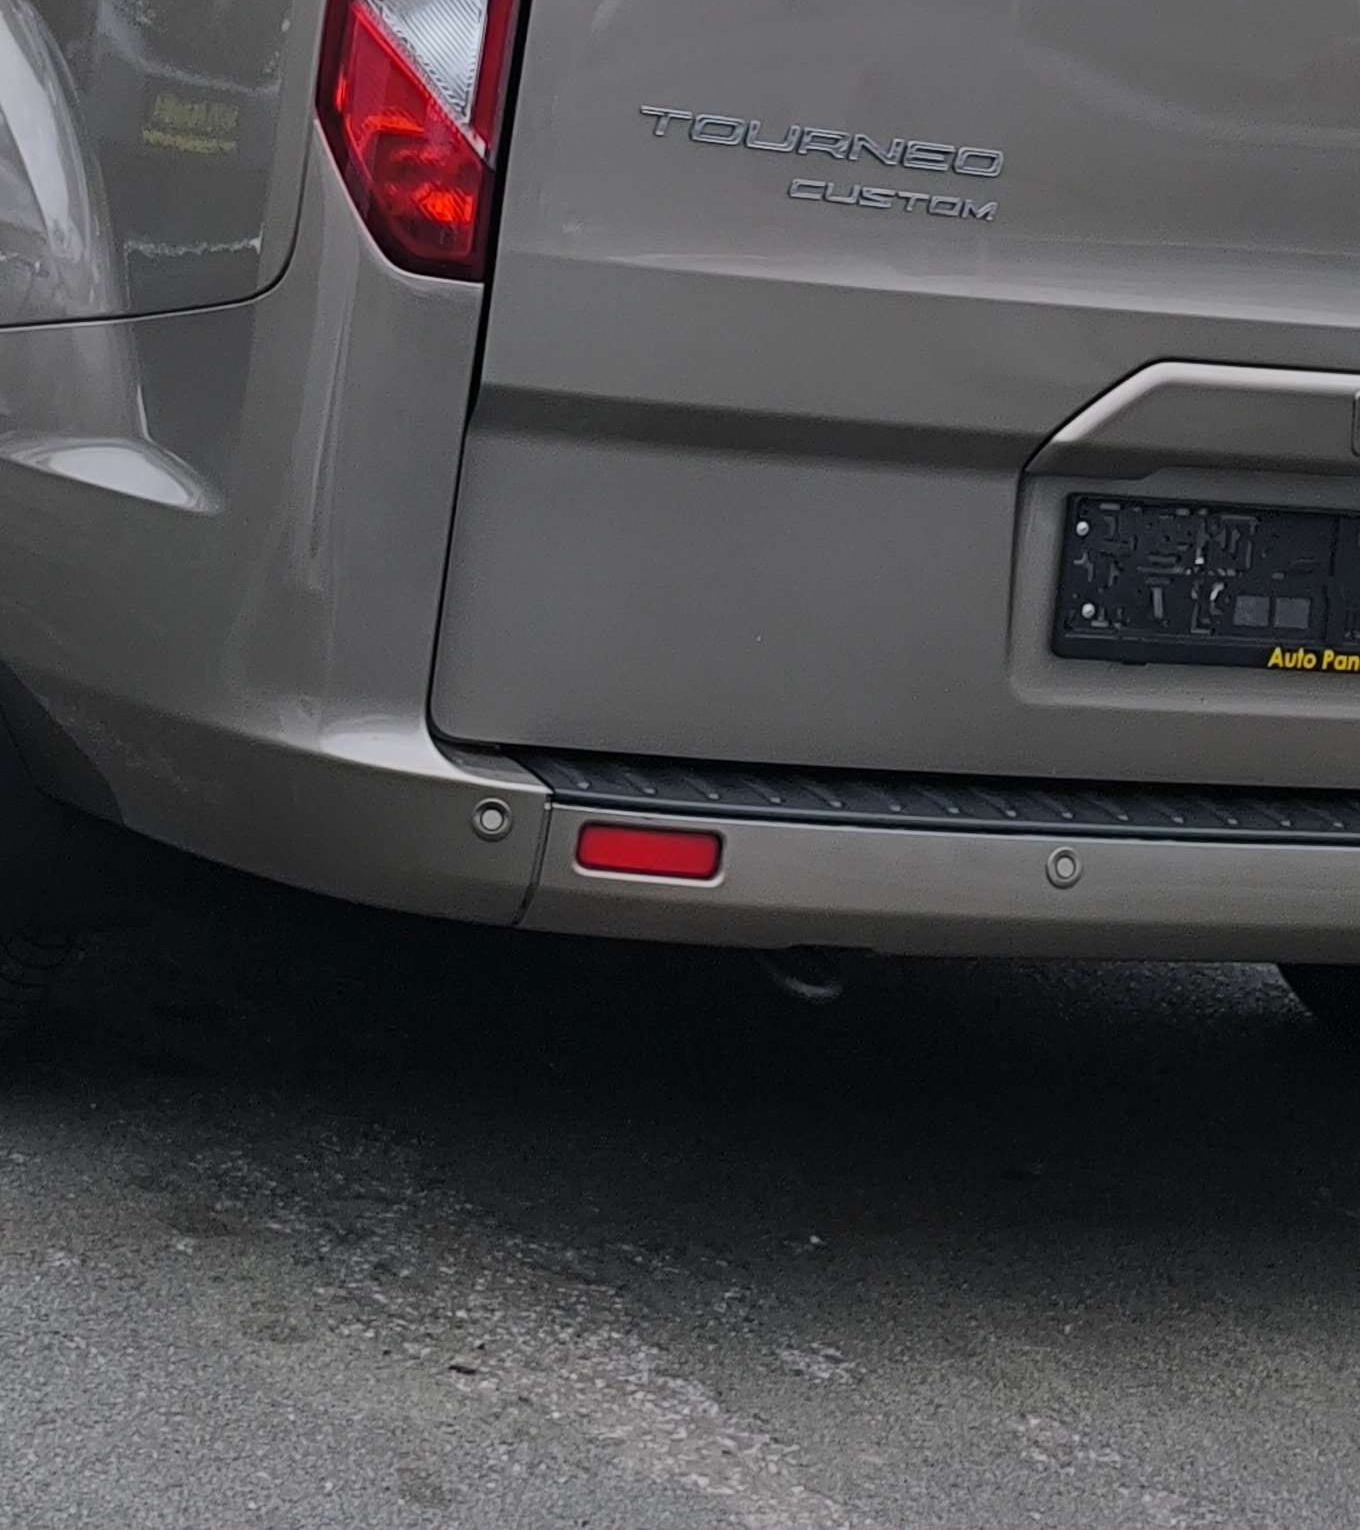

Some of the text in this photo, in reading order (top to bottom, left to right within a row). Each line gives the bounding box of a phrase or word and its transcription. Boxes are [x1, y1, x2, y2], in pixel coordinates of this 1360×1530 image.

[640, 104, 1004, 178] TOURNEO
[788, 178, 999, 222] CUSTOM
[1267, 646, 1317, 669] Auto
